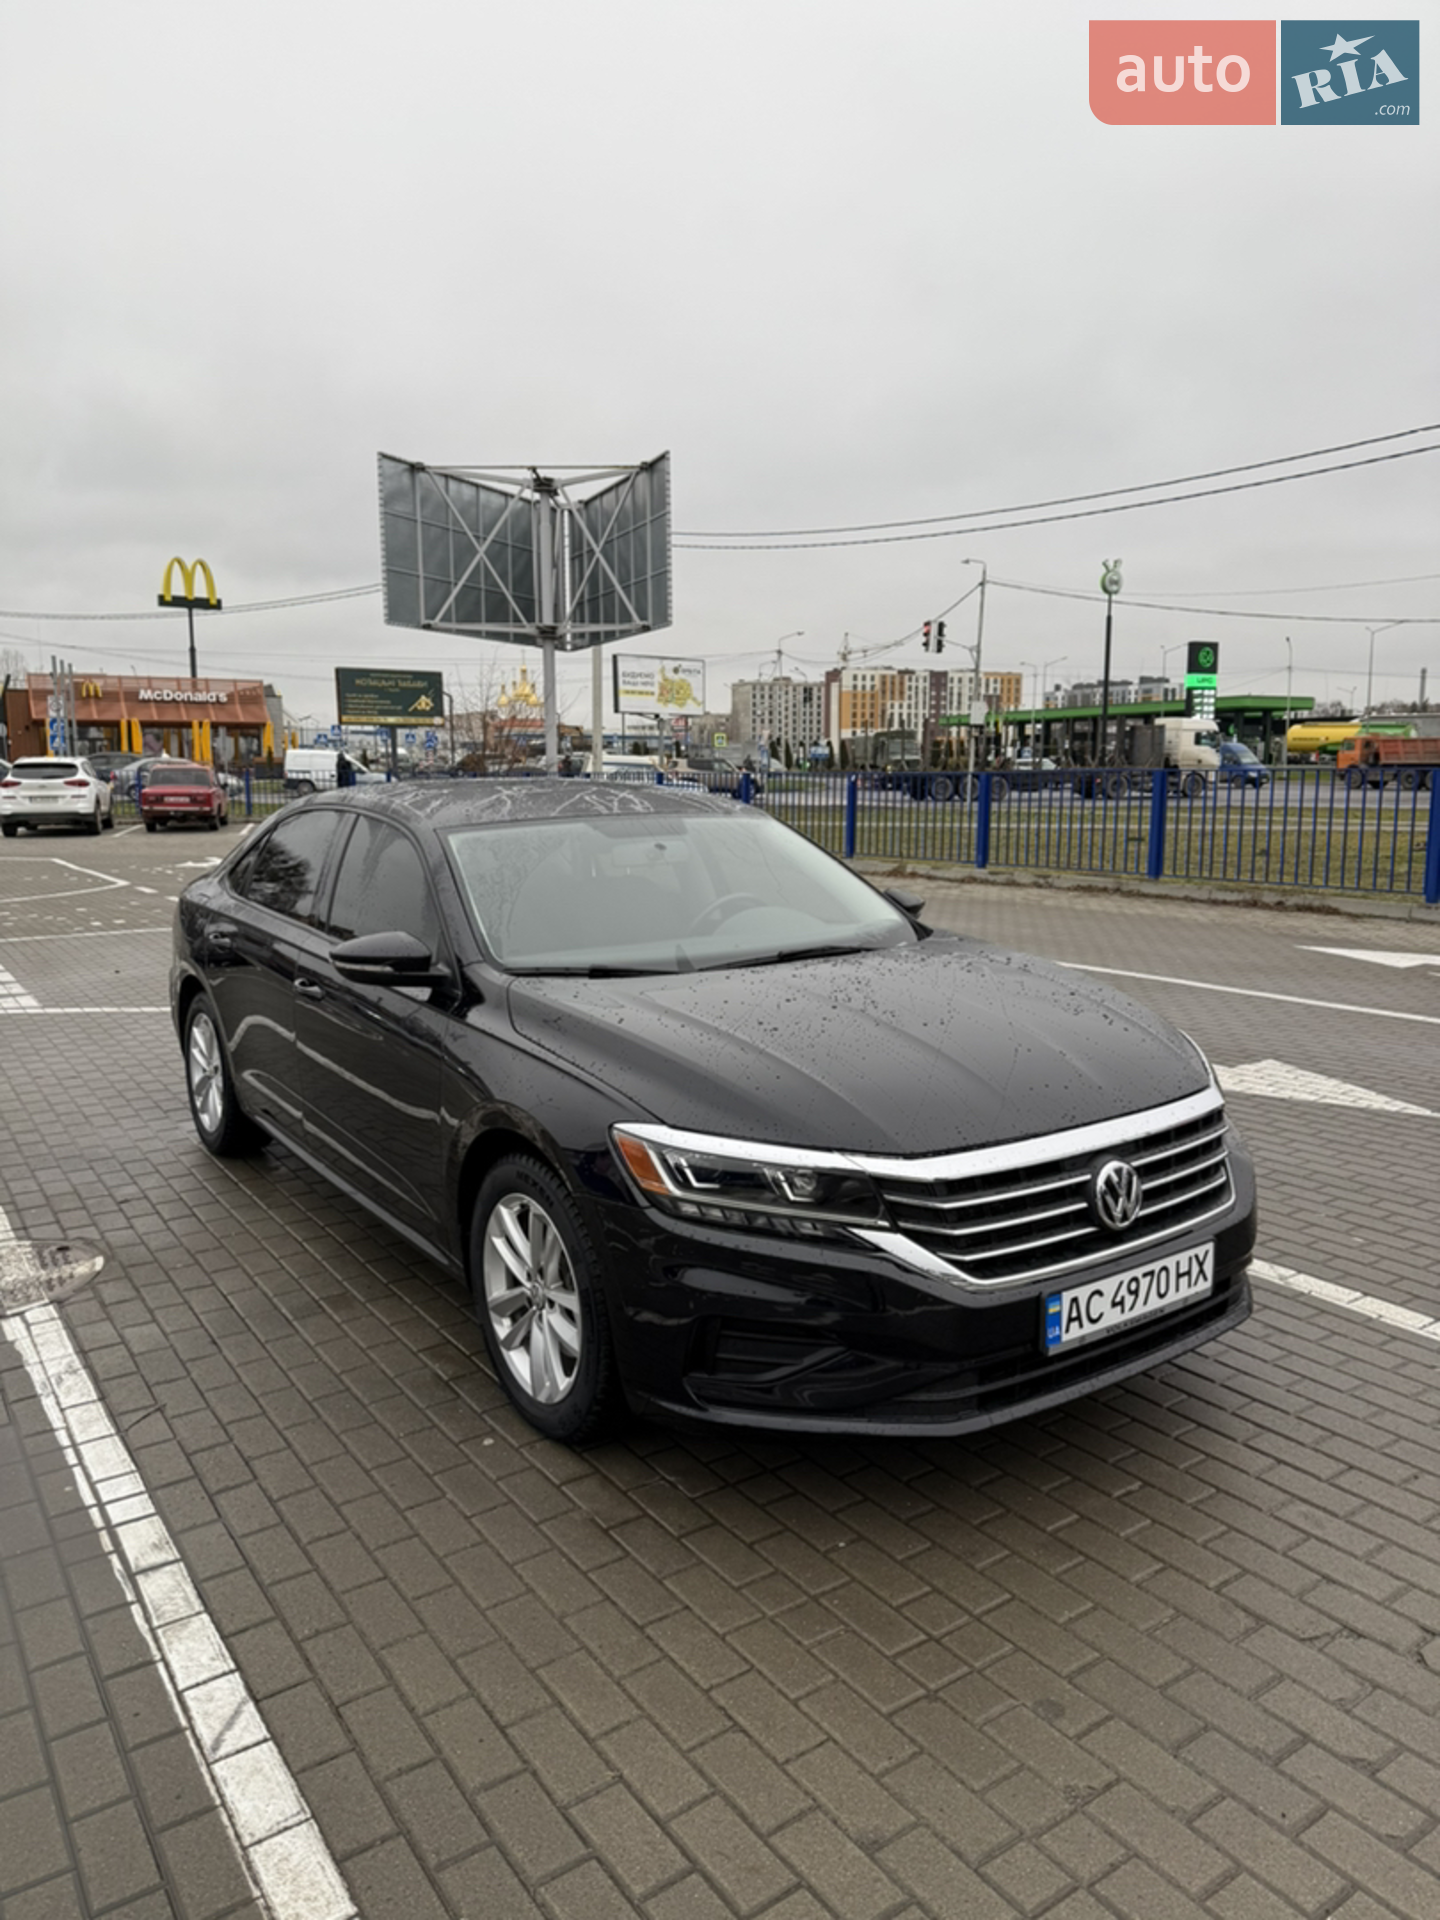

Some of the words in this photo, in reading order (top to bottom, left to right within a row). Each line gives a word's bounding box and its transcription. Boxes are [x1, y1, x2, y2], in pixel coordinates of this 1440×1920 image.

[138, 688, 228, 703] McDonald's
[1065, 1289, 1104, 1334] AC
[1111, 1265, 1170, 1314] 4970
[1175, 1250, 1209, 1293] HX
